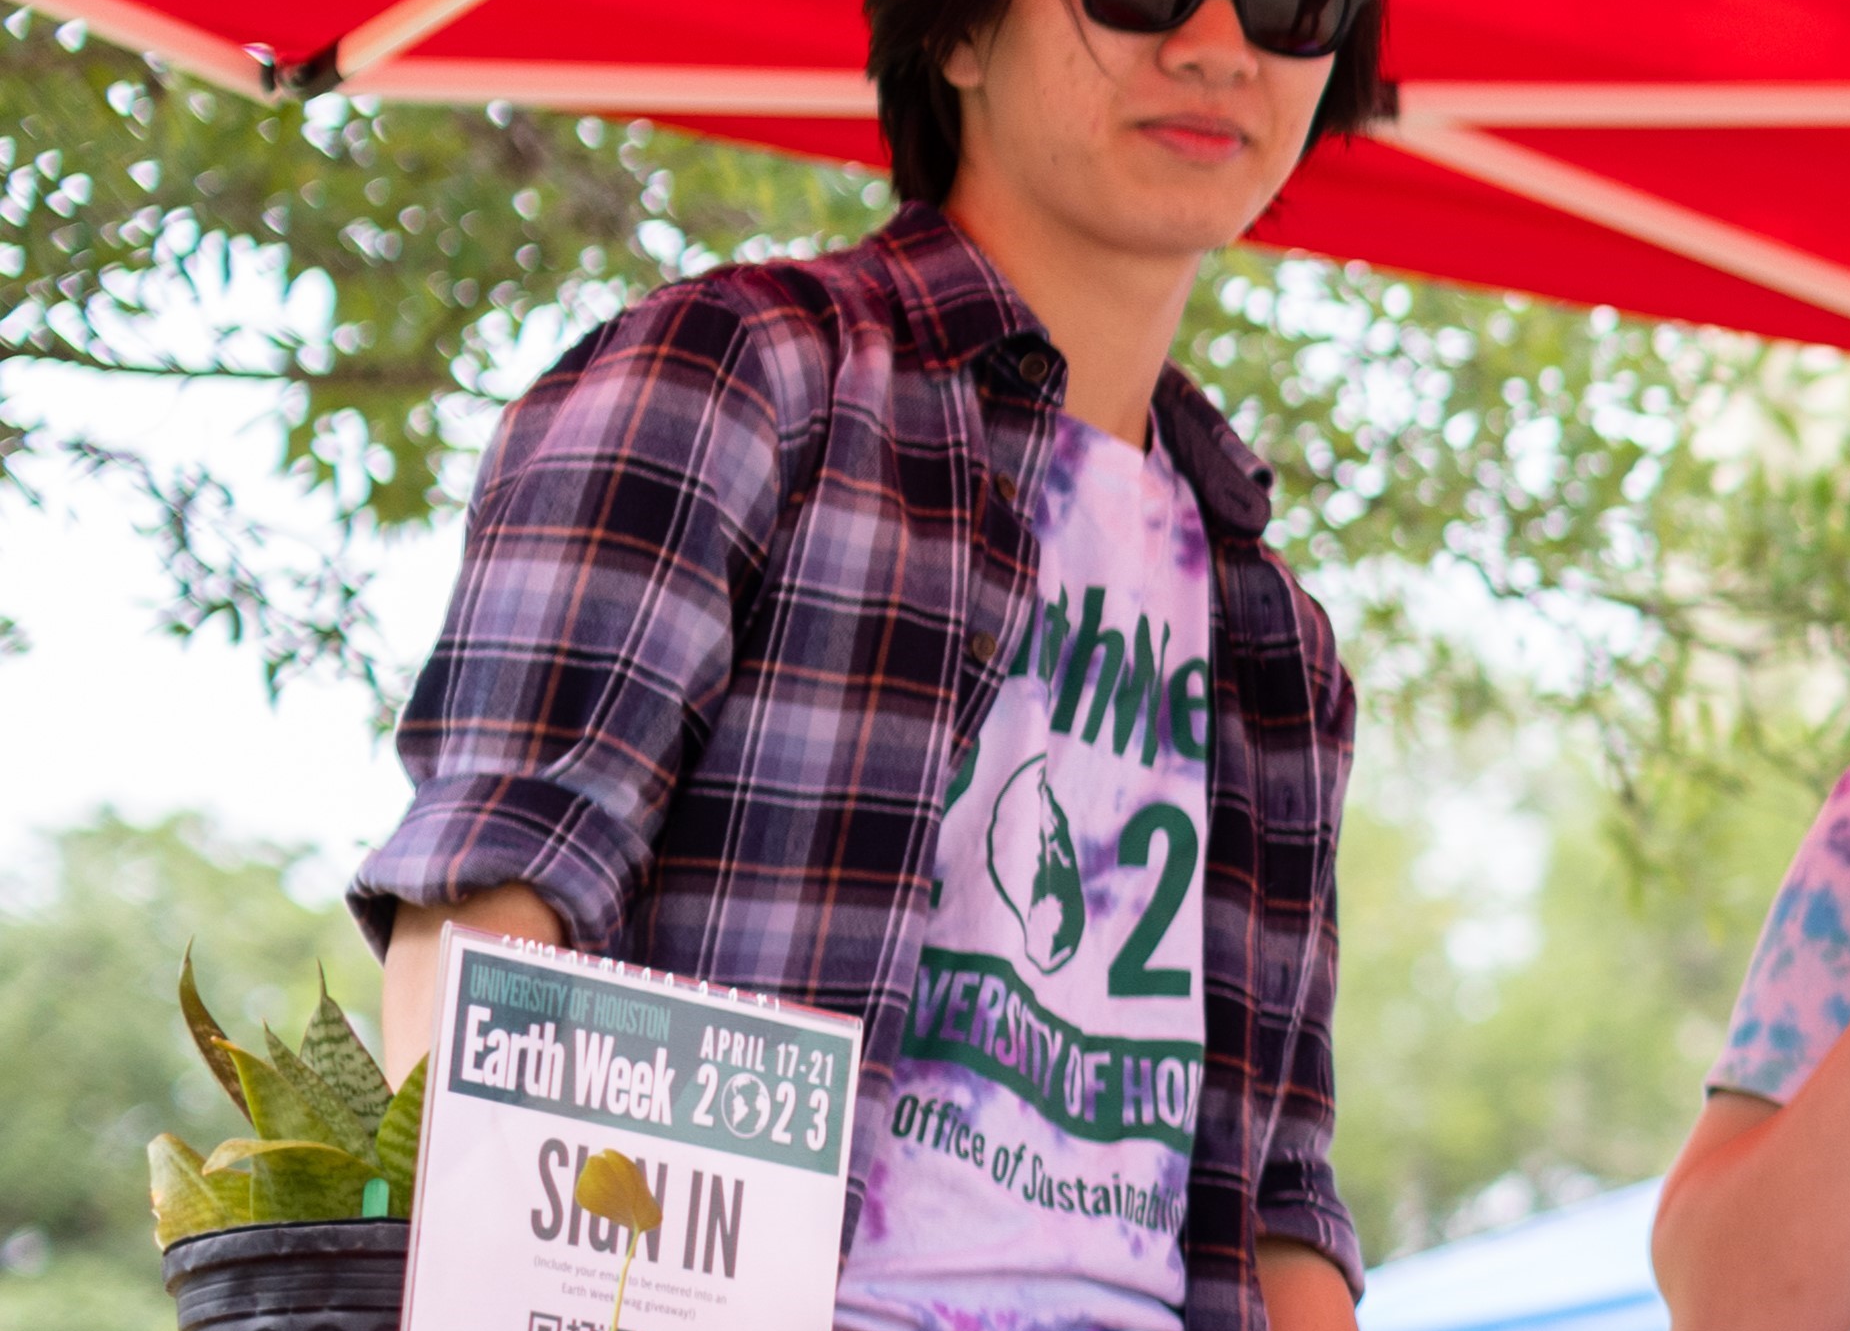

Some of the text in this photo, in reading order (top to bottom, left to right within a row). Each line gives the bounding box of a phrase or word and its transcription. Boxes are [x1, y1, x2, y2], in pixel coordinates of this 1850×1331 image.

[470, 963, 671, 1042] UNIVERSITY OF HOUSTON
[461, 1005, 676, 1126] Earth Week
[700, 1026, 833, 1087] APRIL 17-21
[1064, 1044, 1111, 1123] OF
[891, 1094, 985, 1168] Office
[991, 1143, 1027, 1190] of
[683, 1170, 744, 1280] IN
[562, 1282, 587, 1298] Earth
[622, 1295, 642, 1312] wag
[599, 1269, 622, 1285] ema
